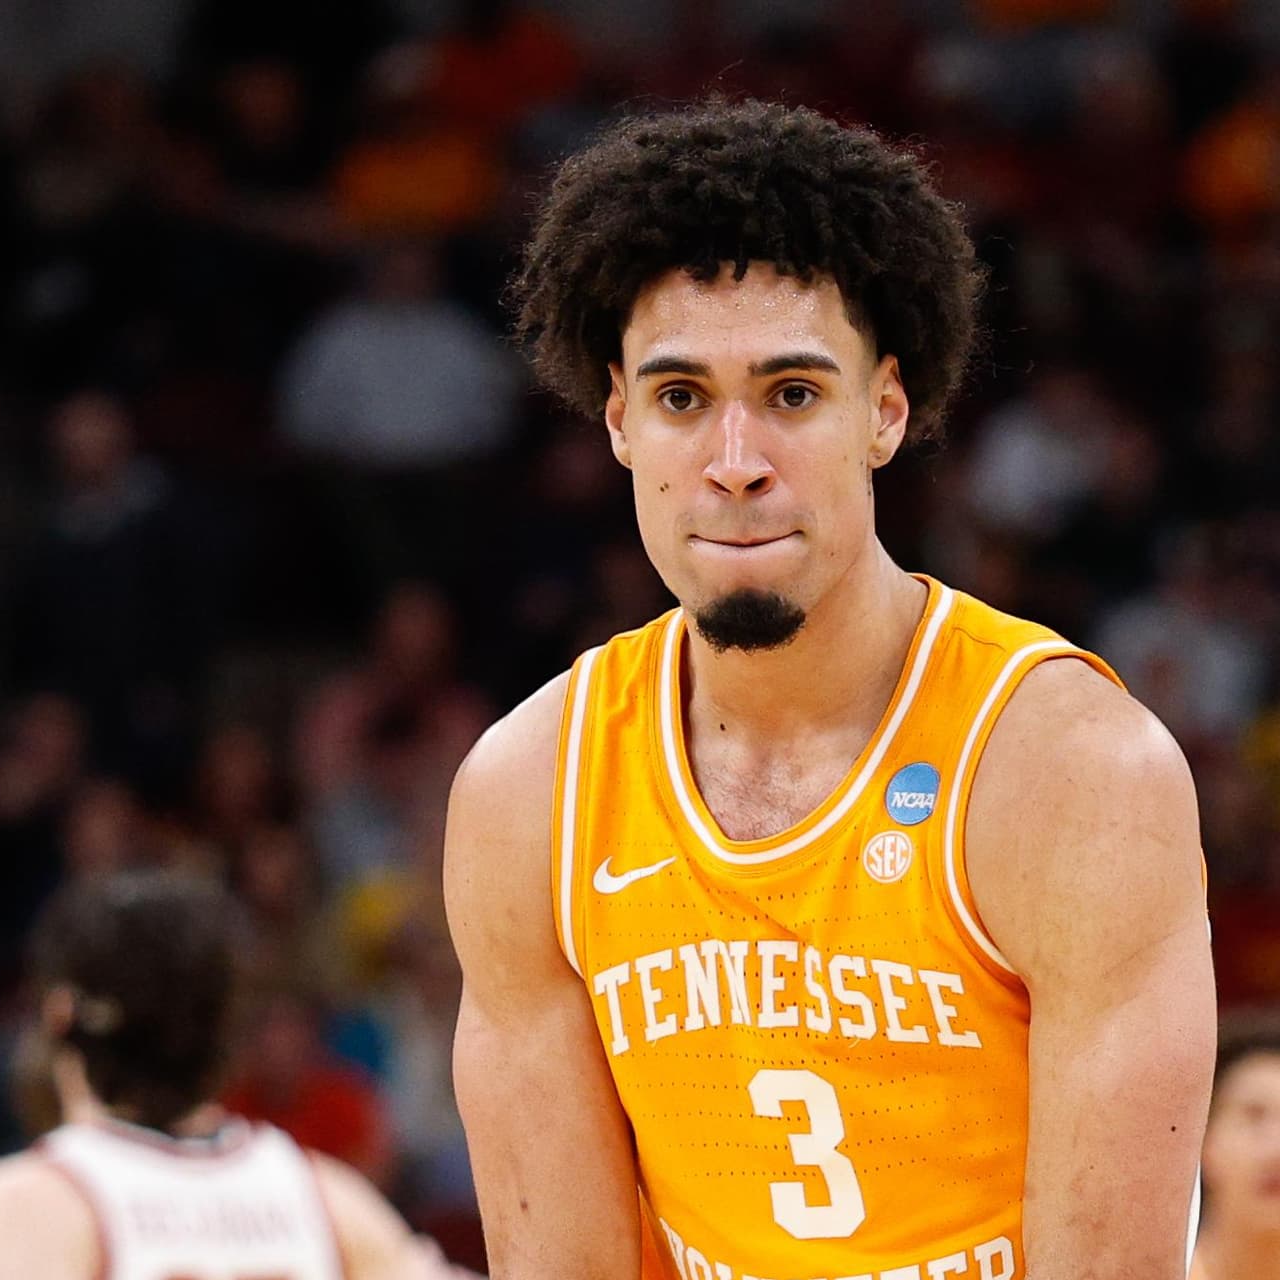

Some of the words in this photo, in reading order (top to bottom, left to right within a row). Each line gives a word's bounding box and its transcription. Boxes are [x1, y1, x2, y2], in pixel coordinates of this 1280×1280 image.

[891, 791, 936, 809] NCAA
[867, 835, 909, 878] SEC
[594, 938, 983, 1057] TENNESSEE
[748, 1069, 866, 1239] 3
